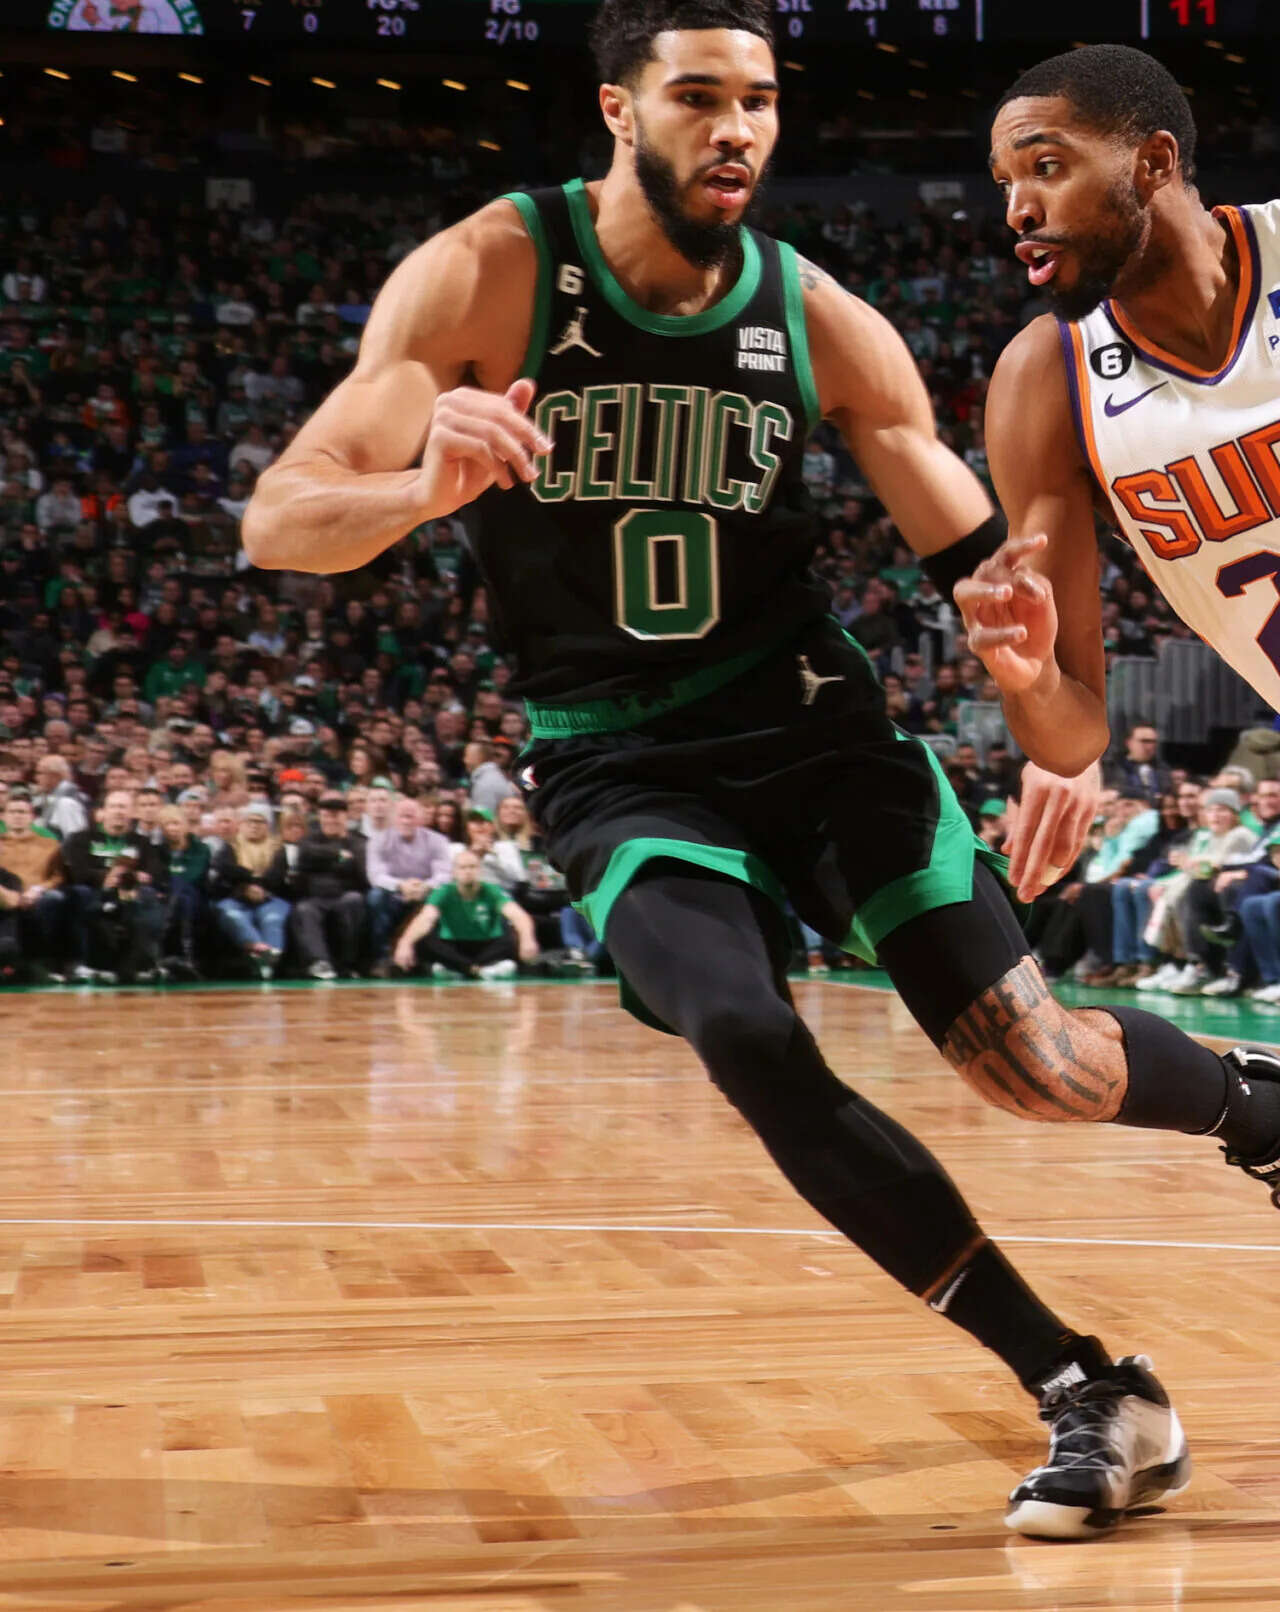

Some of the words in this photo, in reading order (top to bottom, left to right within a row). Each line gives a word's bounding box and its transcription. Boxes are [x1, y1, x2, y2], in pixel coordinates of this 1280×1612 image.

[241, 11, 256, 31] 7
[303, 13, 318, 33] 0
[377, 15, 406, 37] 20
[485, 18, 539, 45] 2/10
[788, 17, 804, 38] 0
[865, 17, 878, 37] 1
[557, 265, 587, 296] 6
[738, 326, 787, 354] VISTA
[737, 351, 787, 373] PRINT
[1101, 350, 1124, 376] 6
[529, 383, 795, 514] CELTICS
[613, 508, 720, 641] 0
